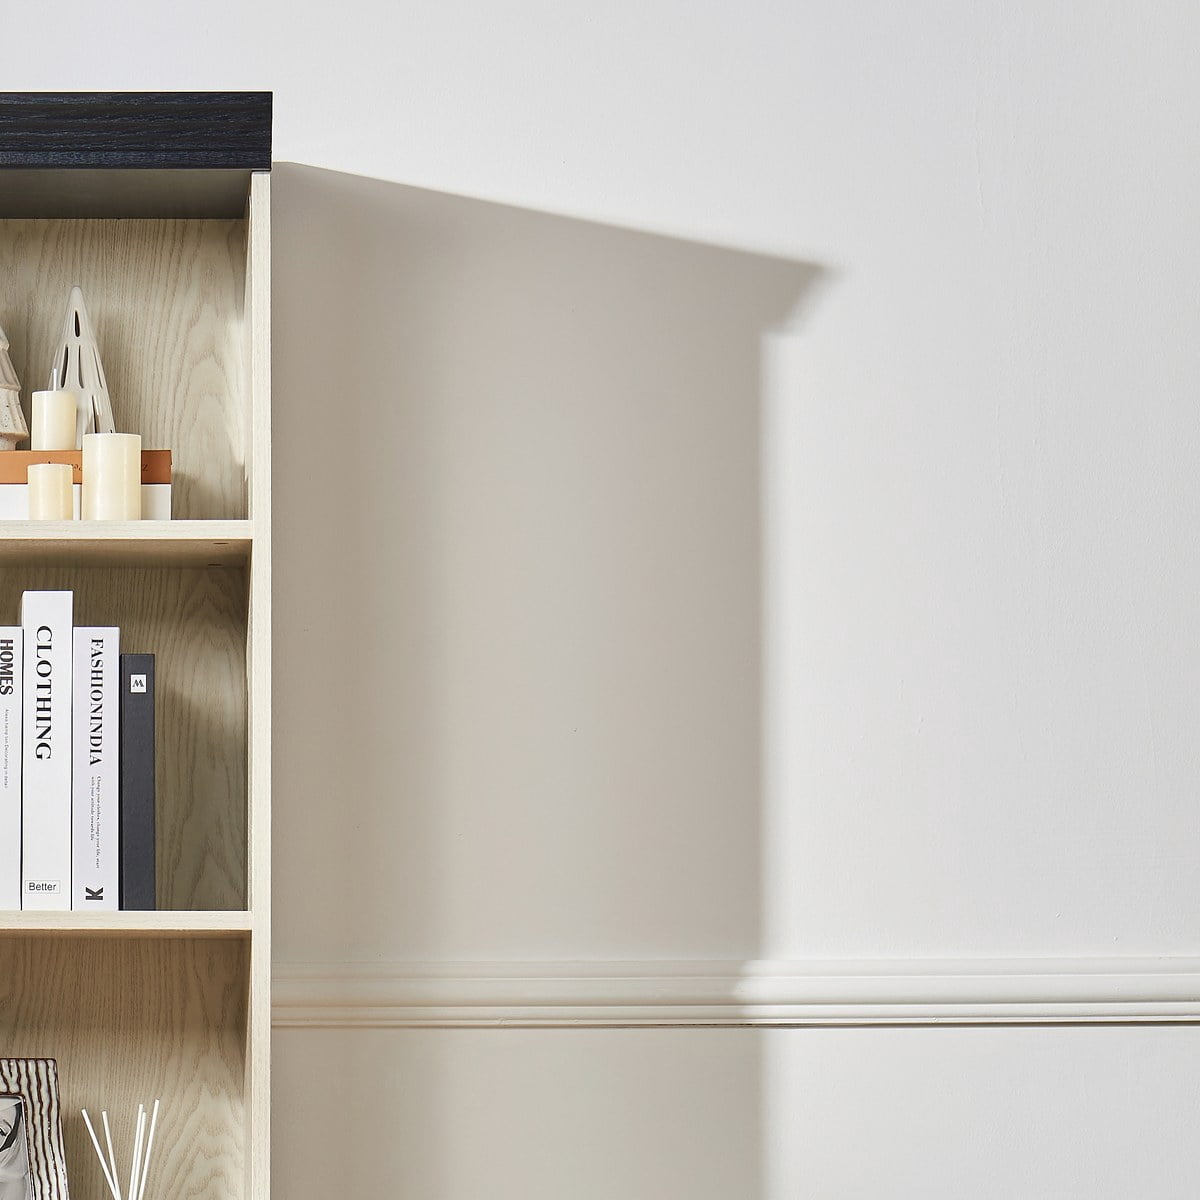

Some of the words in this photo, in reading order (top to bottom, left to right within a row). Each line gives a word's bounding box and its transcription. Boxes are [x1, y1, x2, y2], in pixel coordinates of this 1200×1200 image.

[0, 639, 14, 696] HOMES
[35, 625, 53, 760] CLOTHING
[89, 638, 104, 766] FASHIONINDIA
[28, 882, 57, 891] Better
[85, 887, 104, 901] K
